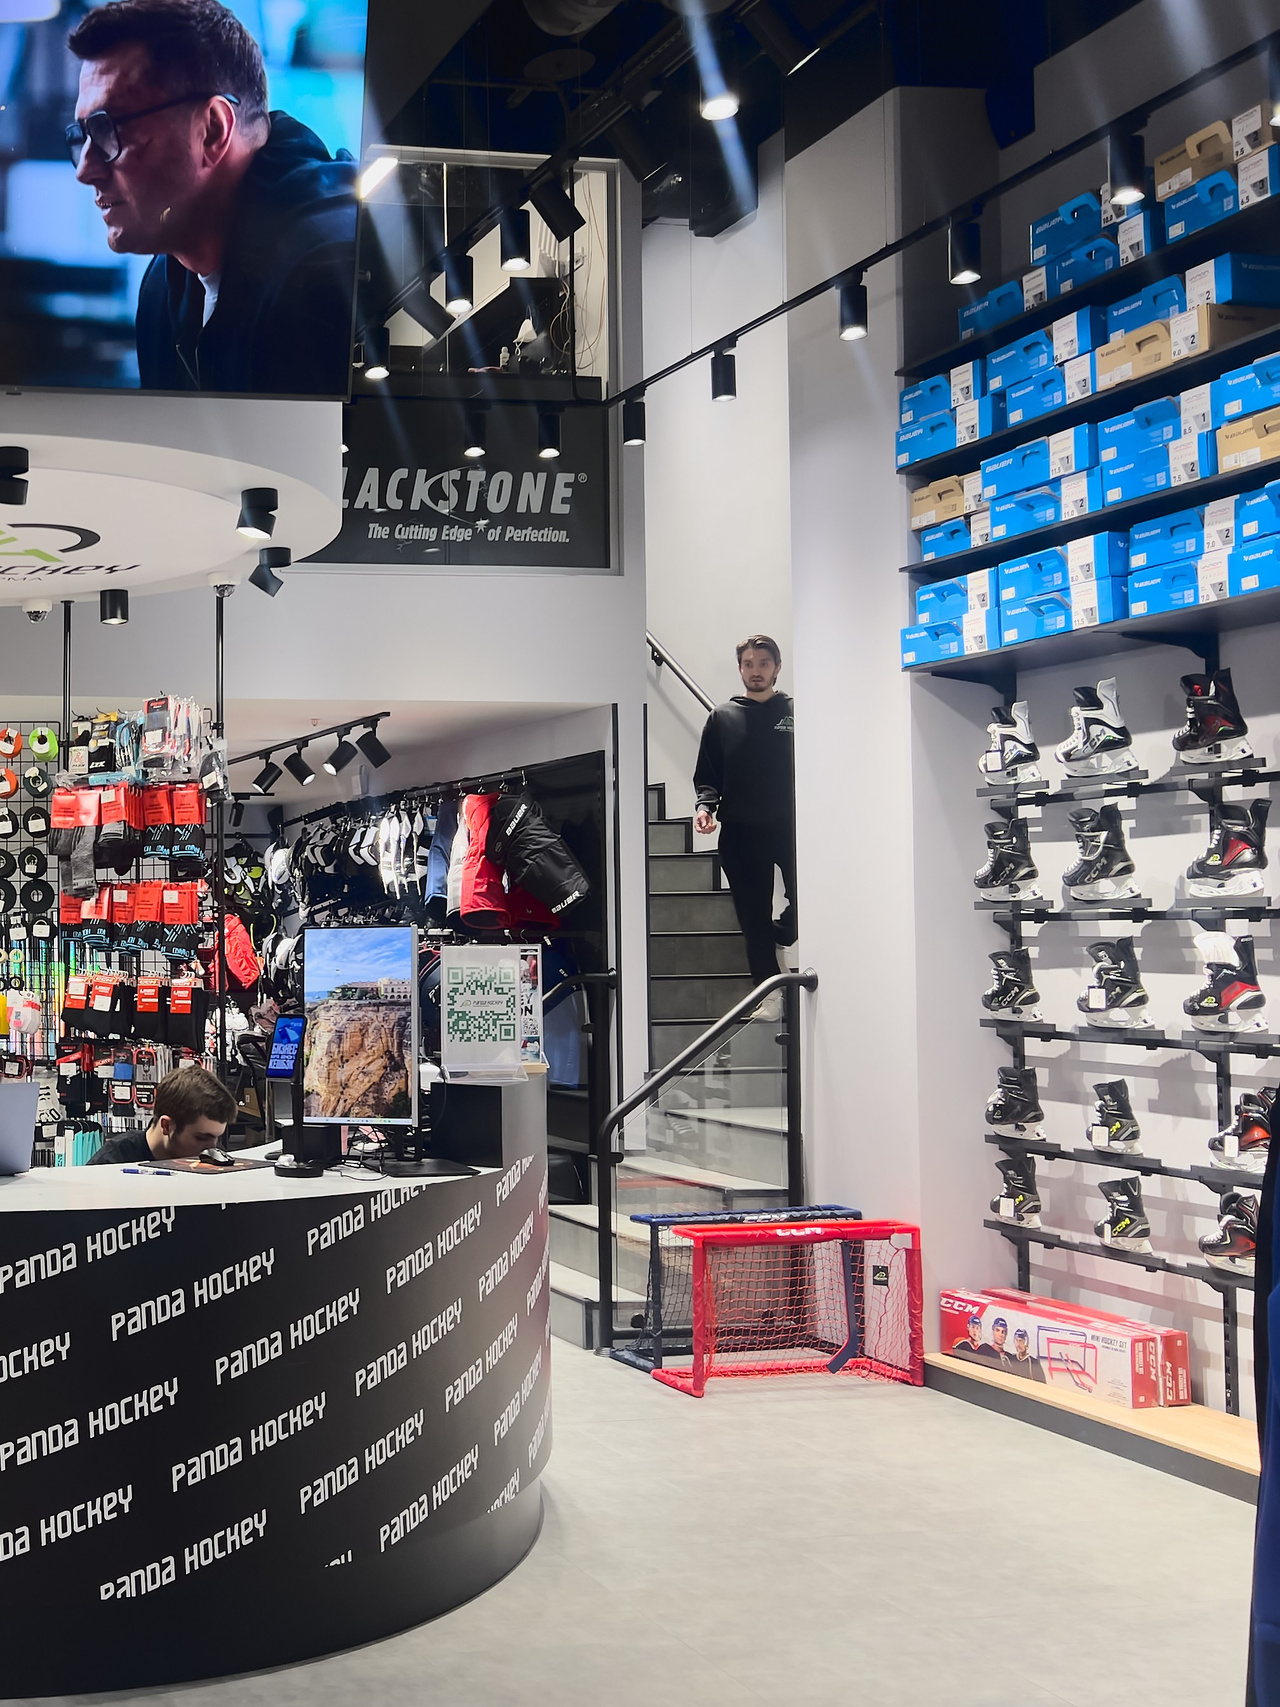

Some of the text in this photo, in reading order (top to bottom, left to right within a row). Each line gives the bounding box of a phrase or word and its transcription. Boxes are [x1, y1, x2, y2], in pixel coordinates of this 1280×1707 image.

[1190, 334, 1196, 344] 2
[970, 425, 975, 434] 2
[985, 458, 1013, 474] BAUER
[1190, 462, 1195, 472] 2
[1079, 499, 1084, 508] 2
[368, 523, 570, 543] The Cutting Edge of Perfection.
[1225, 528, 1230, 538] 2
[1218, 582, 1224, 592] 2
[505, 803, 528, 837] BAUER
[551, 890, 581, 914] BAUER
[940, 1298, 980, 1315] CCM
